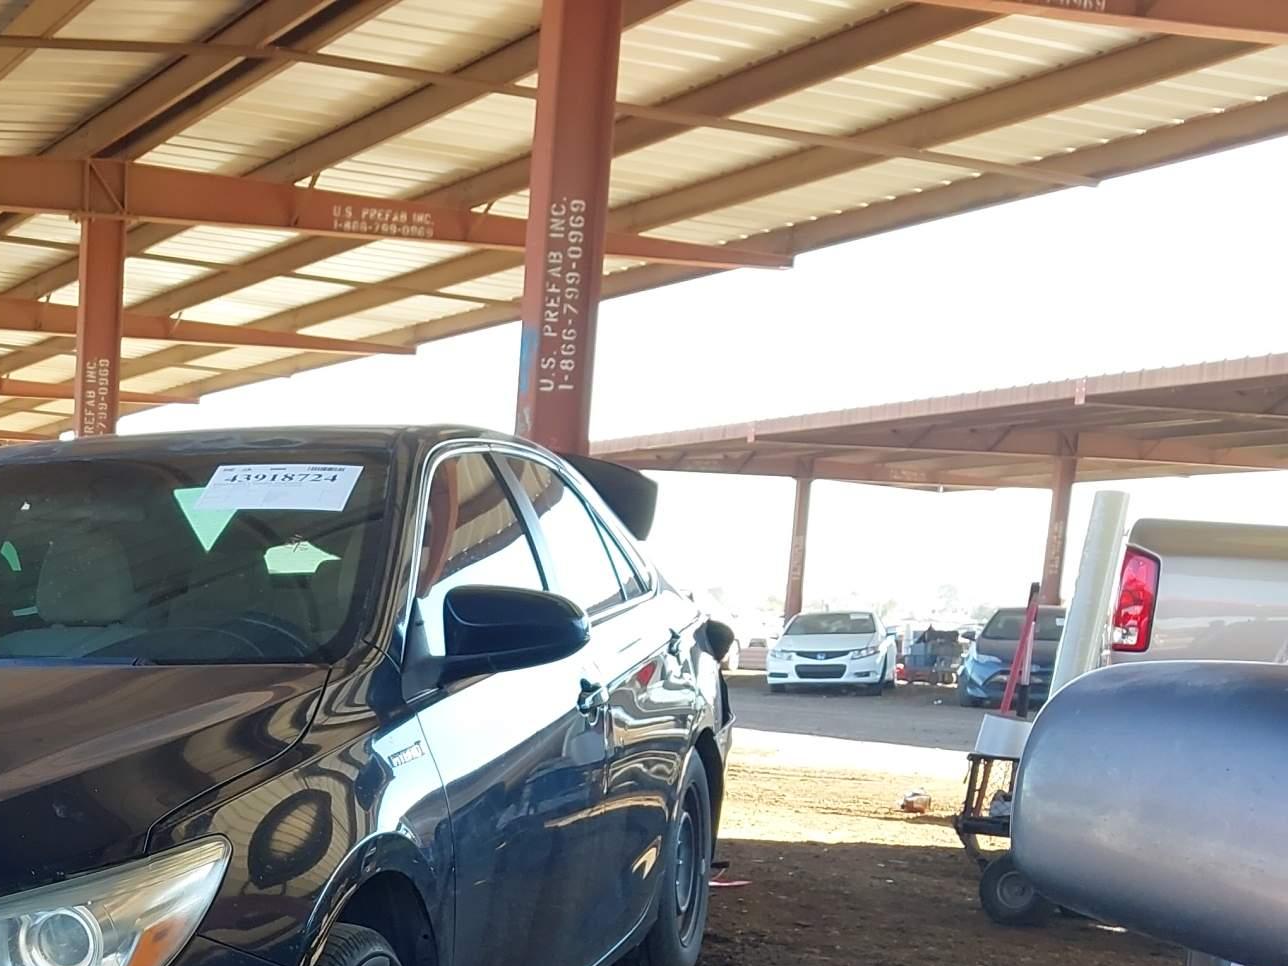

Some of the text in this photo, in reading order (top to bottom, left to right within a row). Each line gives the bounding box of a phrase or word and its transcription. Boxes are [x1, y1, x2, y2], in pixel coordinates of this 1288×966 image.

[361, 208, 408, 224] PREFAB
[539, 196, 567, 391] U.S. PREFAB INC.
[558, 199, 587, 391] 1-866-799-0969
[225, 473, 338, 483] 43918724
